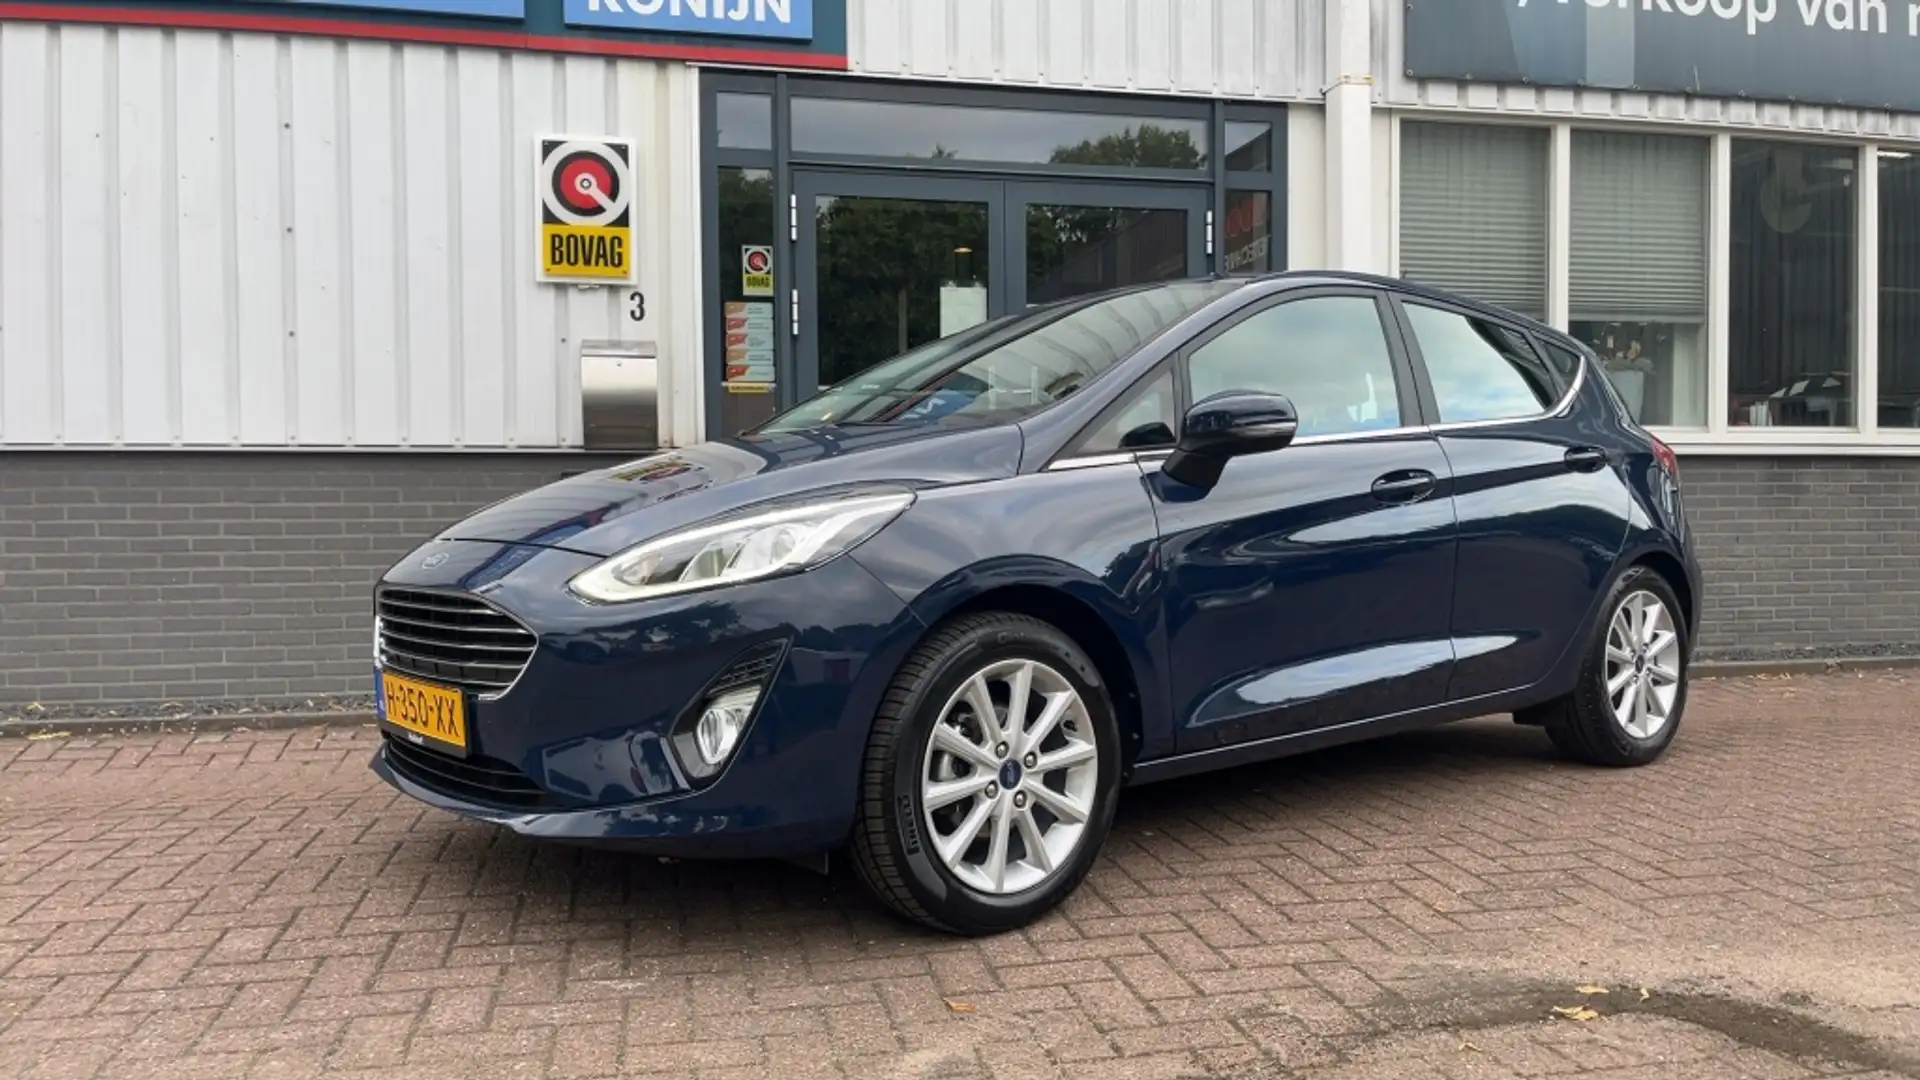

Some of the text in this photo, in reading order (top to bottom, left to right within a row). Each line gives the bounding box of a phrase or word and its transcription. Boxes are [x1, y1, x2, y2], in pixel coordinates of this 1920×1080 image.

[587, 0, 792, 24] NIJN
[1797, 0, 1888, 33] van
[551, 233, 624, 268] BOVAG
[630, 291, 645, 322] 3
[385, 681, 460, 738] H-350-XX
